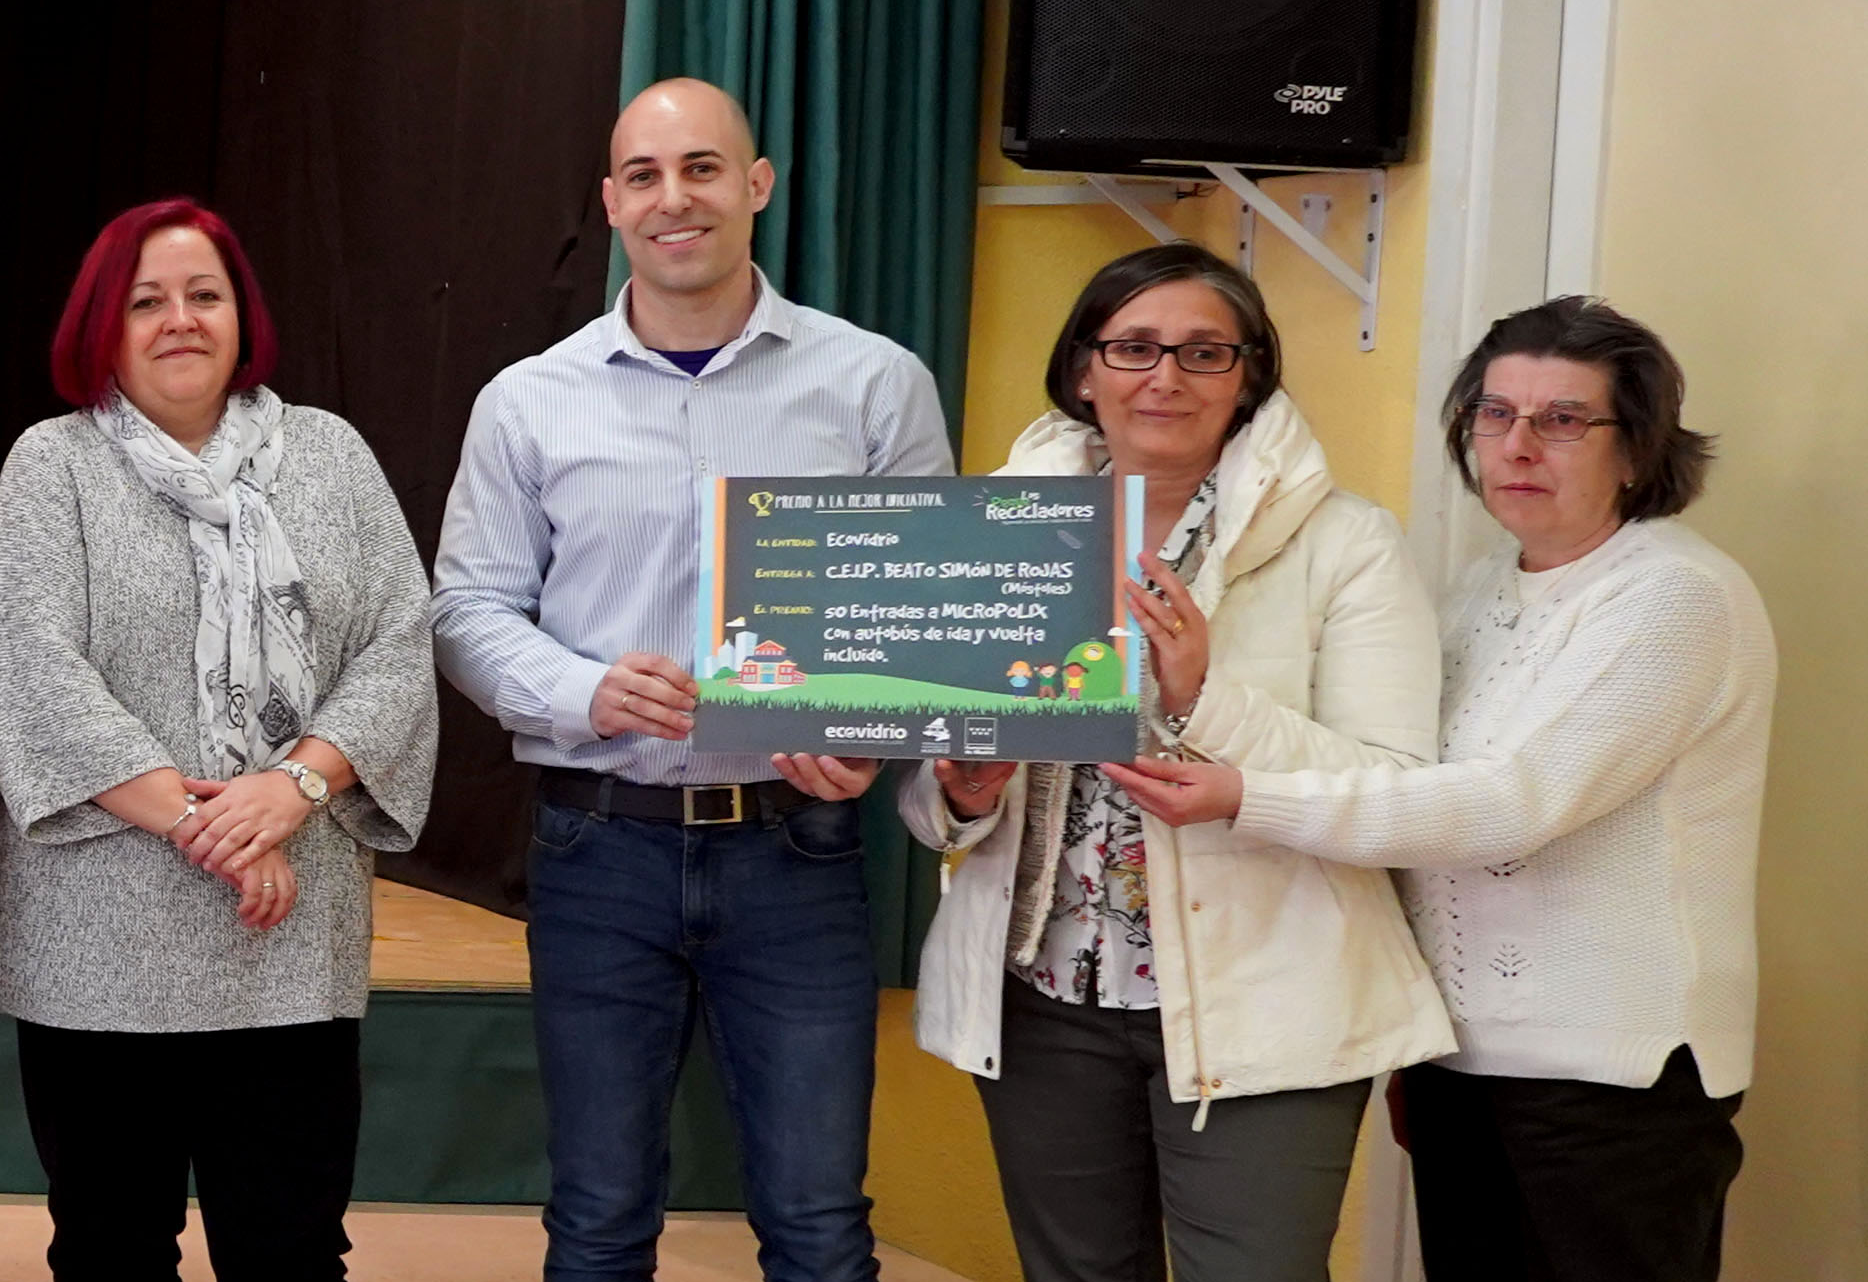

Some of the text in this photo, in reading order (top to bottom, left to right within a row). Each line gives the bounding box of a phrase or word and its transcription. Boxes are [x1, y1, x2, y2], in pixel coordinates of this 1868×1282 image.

[1302, 85, 1348, 102] PYLE
[1290, 99, 1331, 115] PRO
[775, 495, 812, 509] PREMIO
[816, 494, 825, 508] A
[829, 494, 844, 508] LA
[848, 494, 882, 508] MEJOR
[986, 502, 1096, 520] Recicladores
[994, 562, 1015, 578] DE
[850, 603, 925, 623] Entradas
[927, 606, 940, 619] a
[823, 623, 1046, 645] con autobús de ida y vuelta
[823, 646, 889, 663] incluido.
[824, 722, 908, 740] ecovidrio
